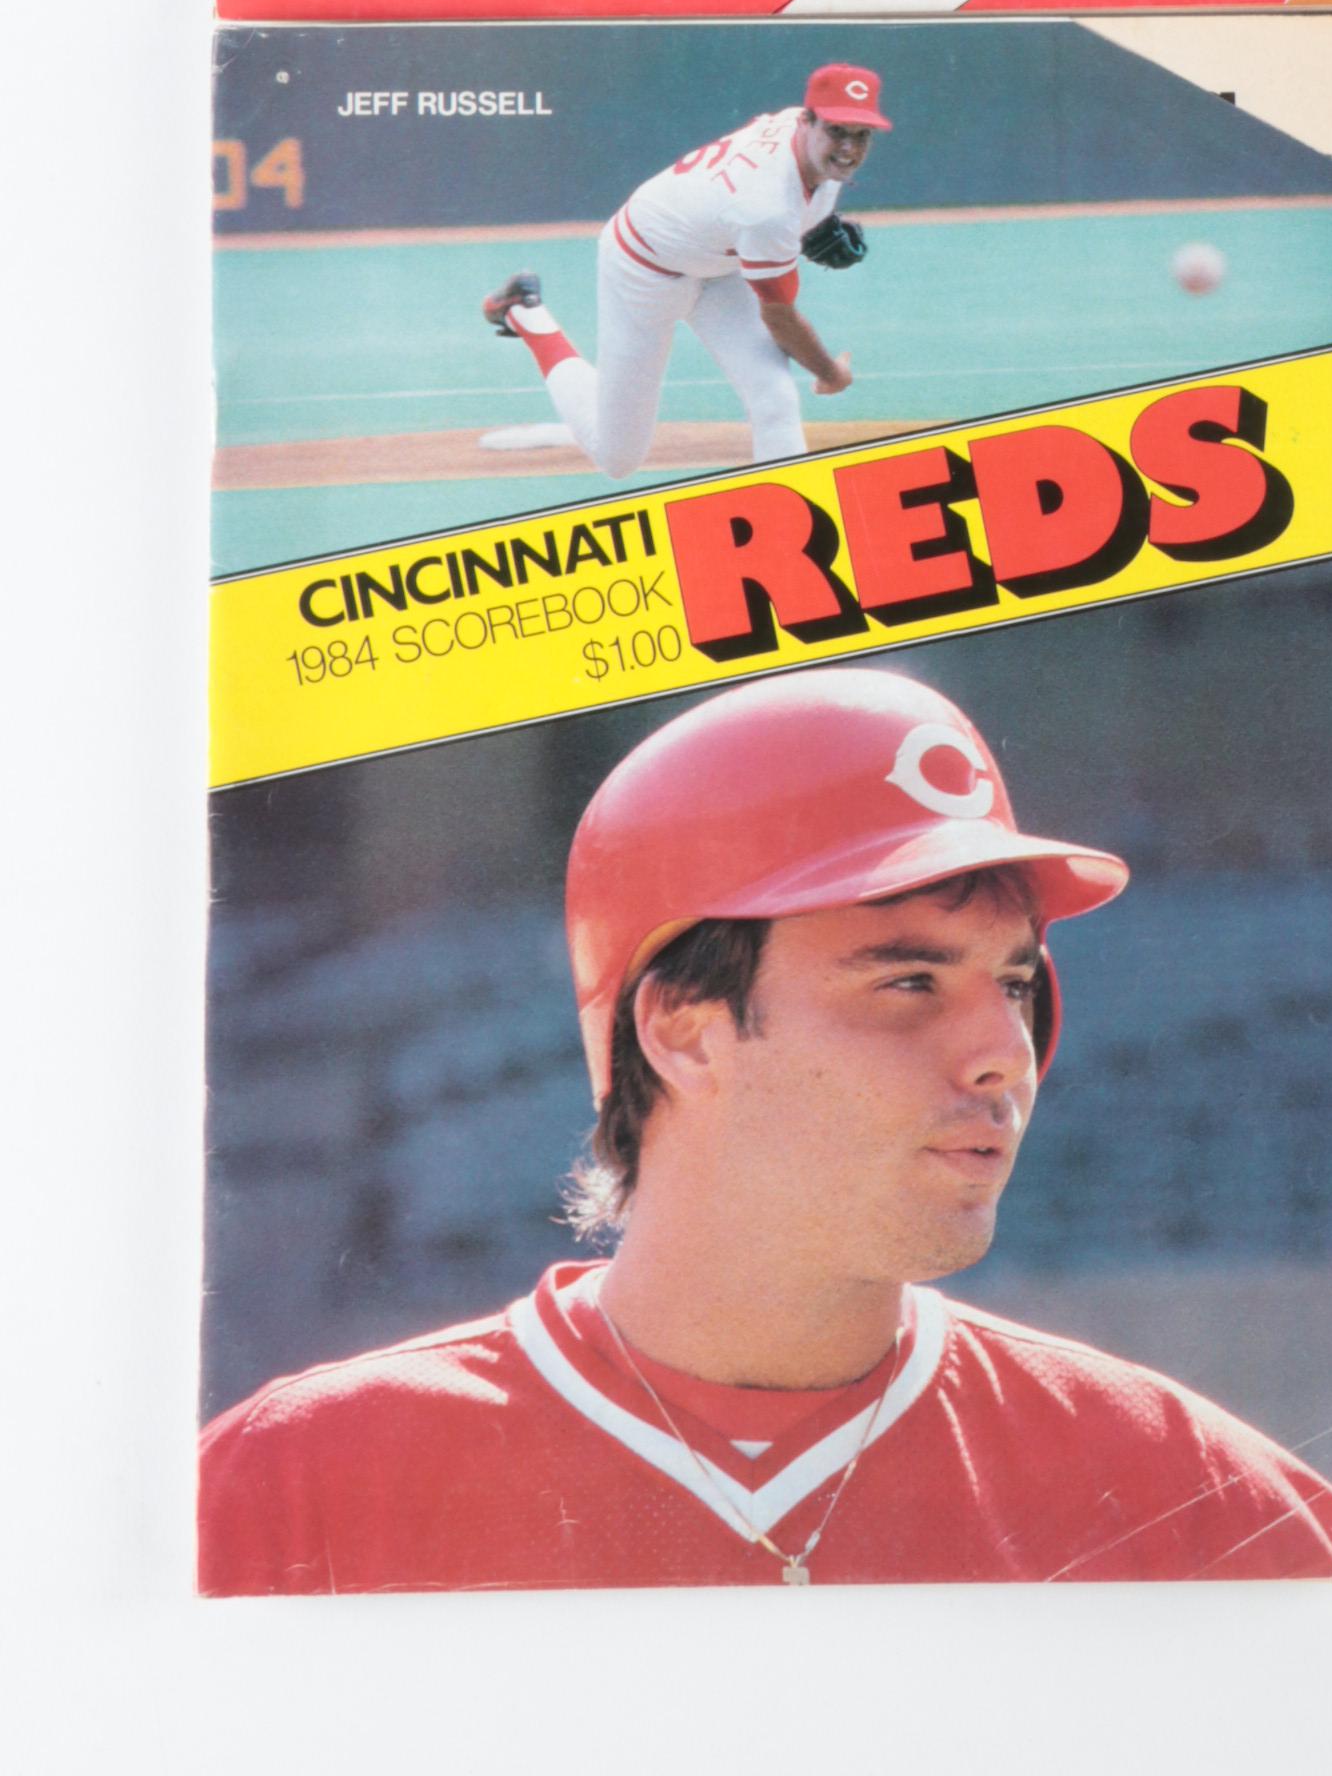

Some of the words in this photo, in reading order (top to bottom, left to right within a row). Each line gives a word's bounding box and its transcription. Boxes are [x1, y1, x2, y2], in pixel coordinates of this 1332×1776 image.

[338, 91, 408, 117] JEFF
[417, 91, 553, 117] RUSSELL
[299, 508, 657, 628] CINCINNATI
[665, 384, 1295, 662] REDS
[286, 634, 379, 687] 1984
[391, 570, 673, 664] SCOREBOOK
[582, 624, 683, 682] $1.00
